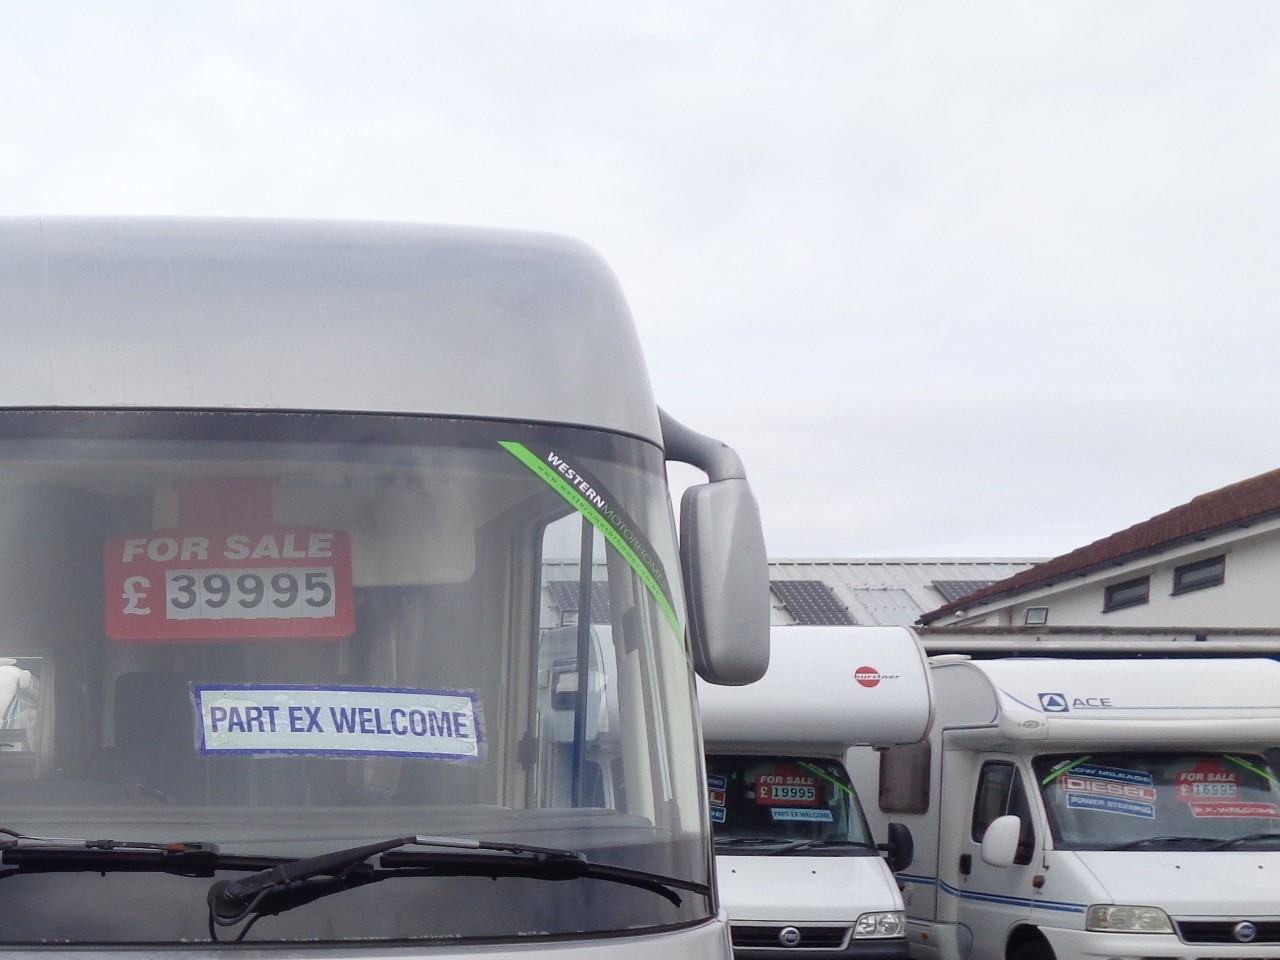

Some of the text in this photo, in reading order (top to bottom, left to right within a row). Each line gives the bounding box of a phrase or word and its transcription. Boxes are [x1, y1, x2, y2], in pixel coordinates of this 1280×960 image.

[122, 533, 333, 562] FOR SALE
[169, 572, 332, 610] 39995
[1073, 698, 1112, 707] ACE
[210, 706, 470, 738] PART EX WELCOME
[760, 775, 814, 785] FOR SALE
[1181, 773, 1235, 782] FOR SALE
[773, 787, 815, 799] 19995
[1067, 779, 1153, 799] DIESEL
